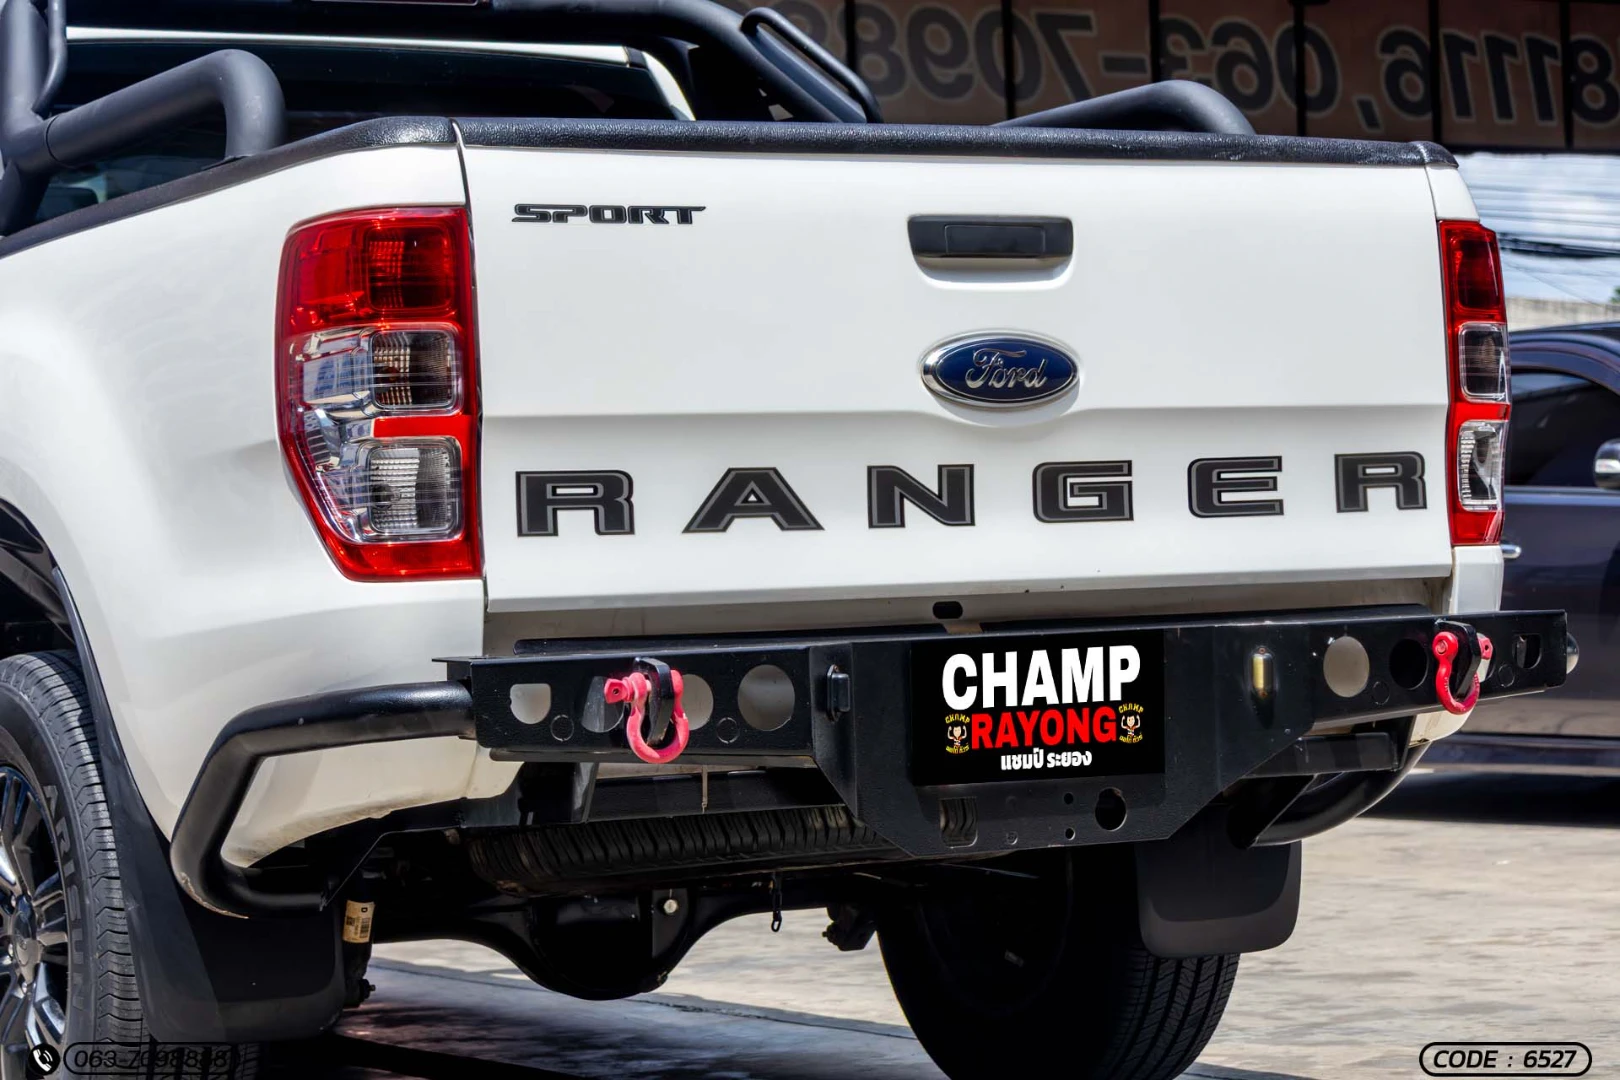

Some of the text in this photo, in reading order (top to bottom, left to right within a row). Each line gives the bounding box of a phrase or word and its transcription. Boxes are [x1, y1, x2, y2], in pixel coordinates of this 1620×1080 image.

[511, 203, 707, 225] SPORT
[964, 347, 1049, 389] Ford
[515, 451, 1428, 538] RANGER
[942, 645, 1141, 711] CHAMP
[971, 706, 1117, 750] RAYONG
[1046, 750, 1093, 769] ระยอง
